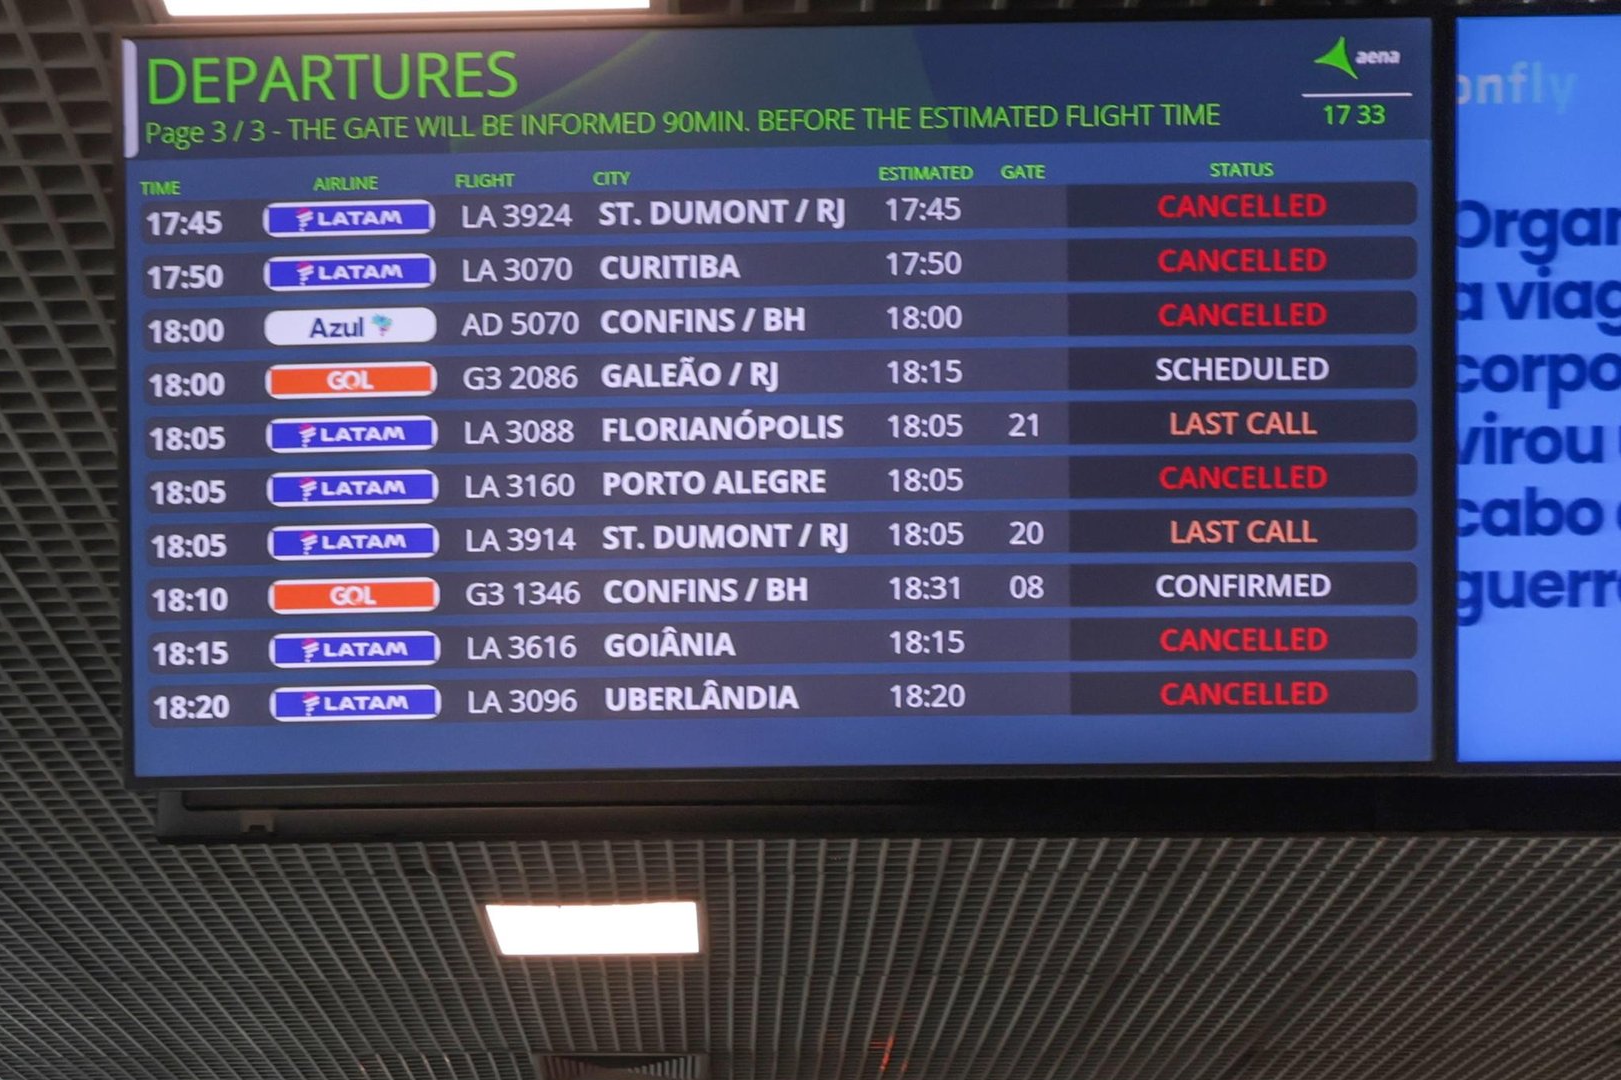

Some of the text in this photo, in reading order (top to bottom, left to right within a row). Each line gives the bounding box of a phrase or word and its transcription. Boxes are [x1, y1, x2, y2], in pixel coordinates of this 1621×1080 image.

[149, 50, 517, 104] DEPARTURES
[1356, 51, 1400, 64] aena
[146, 122, 204, 150] Page
[212, 121, 226, 142] 3
[233, 120, 244, 142] /
[251, 120, 265, 141] 3
[287, 118, 336, 140] THE
[344, 116, 408, 139] GATE
[415, 116, 476, 137] WILL
[482, 114, 514, 136] BE
[522, 112, 655, 135] INFORMED
[663, 111, 749, 133] 90MIN.
[758, 108, 855, 131] BEFORE
[862, 106, 911, 129] THE
[919, 105, 1058, 129] ESTIMATED
[1067, 104, 1154, 127] FLIGHT
[1160, 102, 1220, 125] TIME
[140, 161, 1275, 195] TIME AIRLINE FLIGHT CITY ESTIMATED GATE STATUS
[147, 194, 1327, 235] 17:45 LATAM LA 3924 ST. DUMONT / RJ 17:45 CANCELLED
[148, 248, 1327, 289] 17:50 LATAM LA 3070 CURITIBA 17:50 CANCELLED
[148, 303, 1327, 343] 18:00 Azul AD 5070 CONFINS / BH 18:00 CANCELLED
[149, 357, 1329, 397] 18:00 GOL G3 2086 GALEÃO / RJ 18:15 SCHEDULED
[150, 409, 1317, 451] 18:05 LATAM LA 3088 FLORIANÓPOLIS 18:05 21 LAST CALL
[1457, 411, 1604, 464] virou
[151, 465, 1327, 504] 18:05 LATAM LA 3160 PORTO ALEGRE 18:05 CANCELLED
[1457, 486, 1604, 537] cabo
[152, 520, 1318, 558] 18:05 LATAM LA 3914 ST. DUMONT / RJ 18:05 20 LAST CALL
[153, 574, 1331, 612] 18:10 GOL G3 1346 CONFINS / BH 18:31 08 CONFIRMED
[1457, 569, 1621, 627] guerr
[153, 626, 1328, 665] 18:15 LATAM LA 3616 GOIÂNIA 18:15 CANCELLED
[154, 680, 1328, 719] 18:20 LATAM LA 3096 UBERLÂNDIA 18:20 CANCELLED
